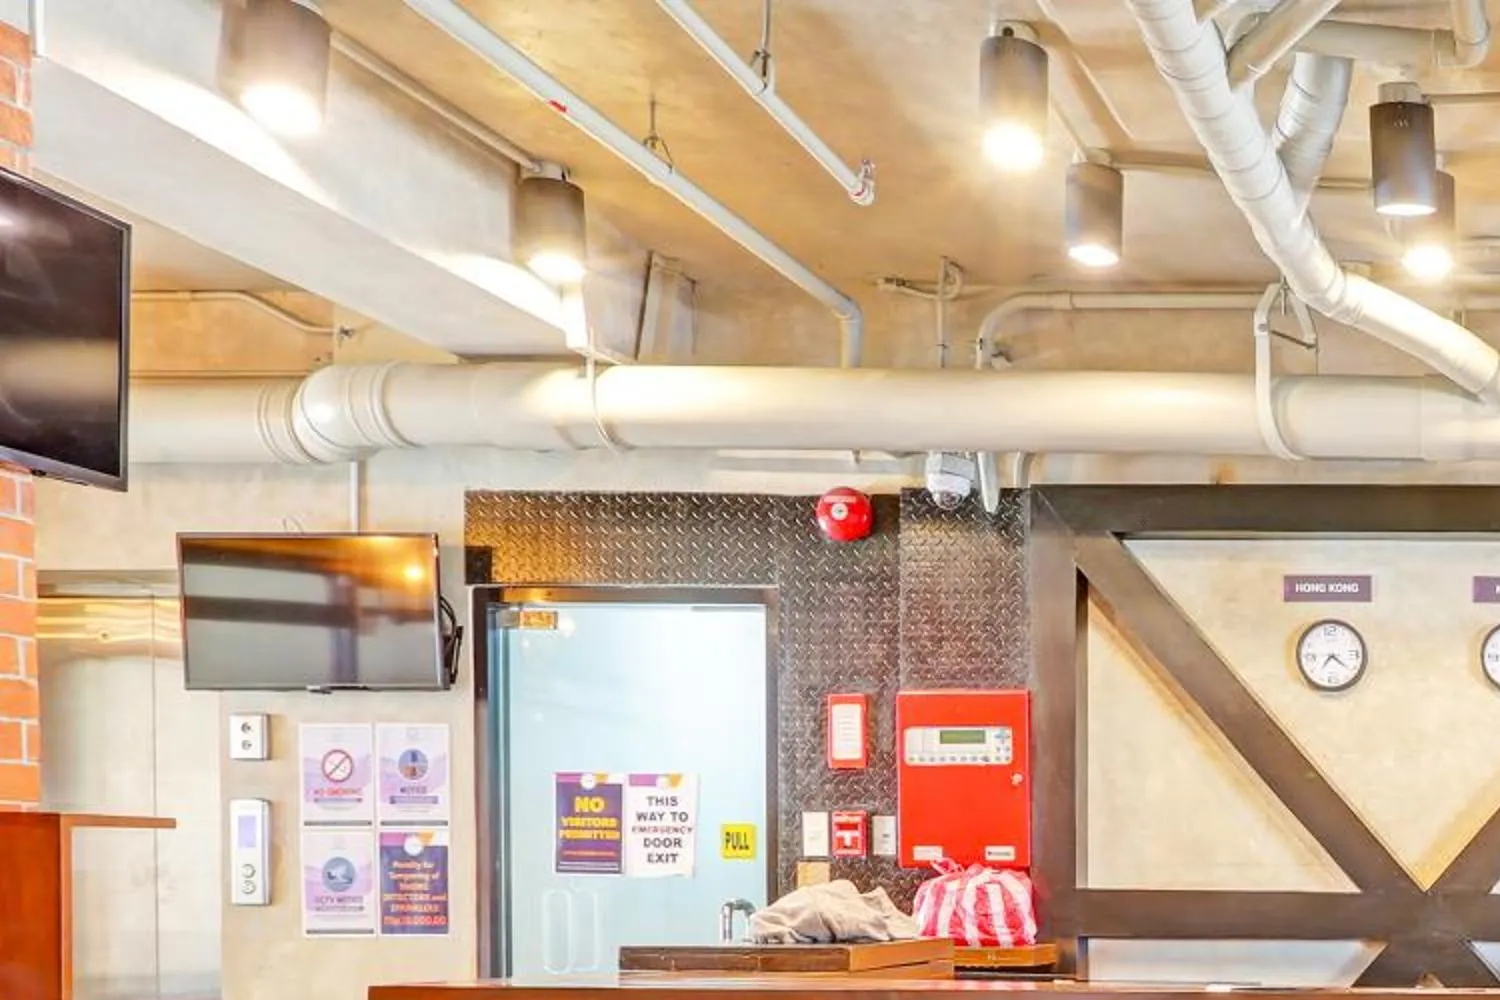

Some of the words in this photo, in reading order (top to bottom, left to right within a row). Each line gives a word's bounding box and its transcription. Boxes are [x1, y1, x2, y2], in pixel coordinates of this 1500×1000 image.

[1295, 583, 1326, 593] HONG
[1328, 583, 1360, 593] KONG
[1323, 625, 1338, 637] 12
[575, 796, 605, 813] NO
[646, 796, 679, 807] THIS
[636, 811, 665, 822] WAY
[670, 811, 689, 822] TO
[631, 825, 692, 834] EMERGENCY
[643, 837, 683, 848] DOOR
[725, 831, 750, 850] PULL
[647, 853, 679, 864] EXIT
